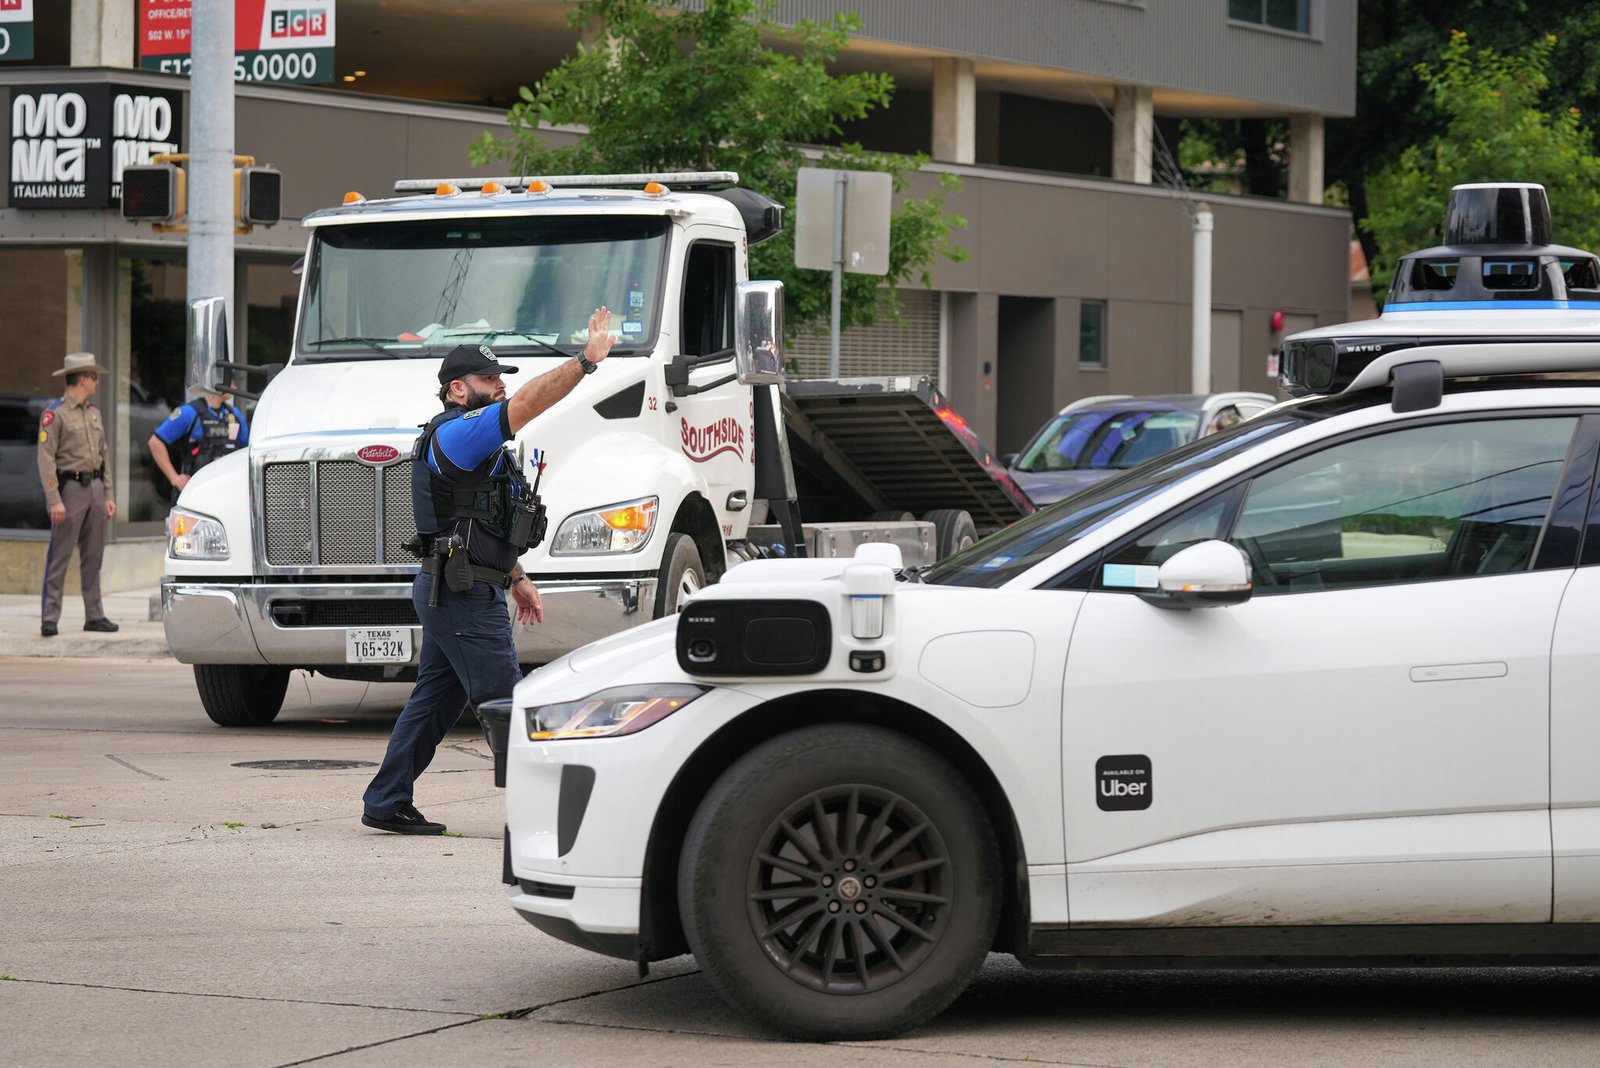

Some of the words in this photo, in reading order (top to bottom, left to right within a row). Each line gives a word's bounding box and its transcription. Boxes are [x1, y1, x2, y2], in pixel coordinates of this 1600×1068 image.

[147, 8, 193, 20] OFFICE/RET
[273, 14, 323, 33] ECR
[12, 92, 87, 138] MO
[113, 94, 172, 141] MO
[14, 184, 57, 198] ITALIAN
[59, 184, 86, 198] LUXE
[648, 396, 657, 410] 32
[681, 416, 745, 454] SOUTHSIDE
[361, 447, 396, 458] Peterbilt
[367, 630, 392, 638] TEXAS
[1101, 780, 1147, 797] Uber
